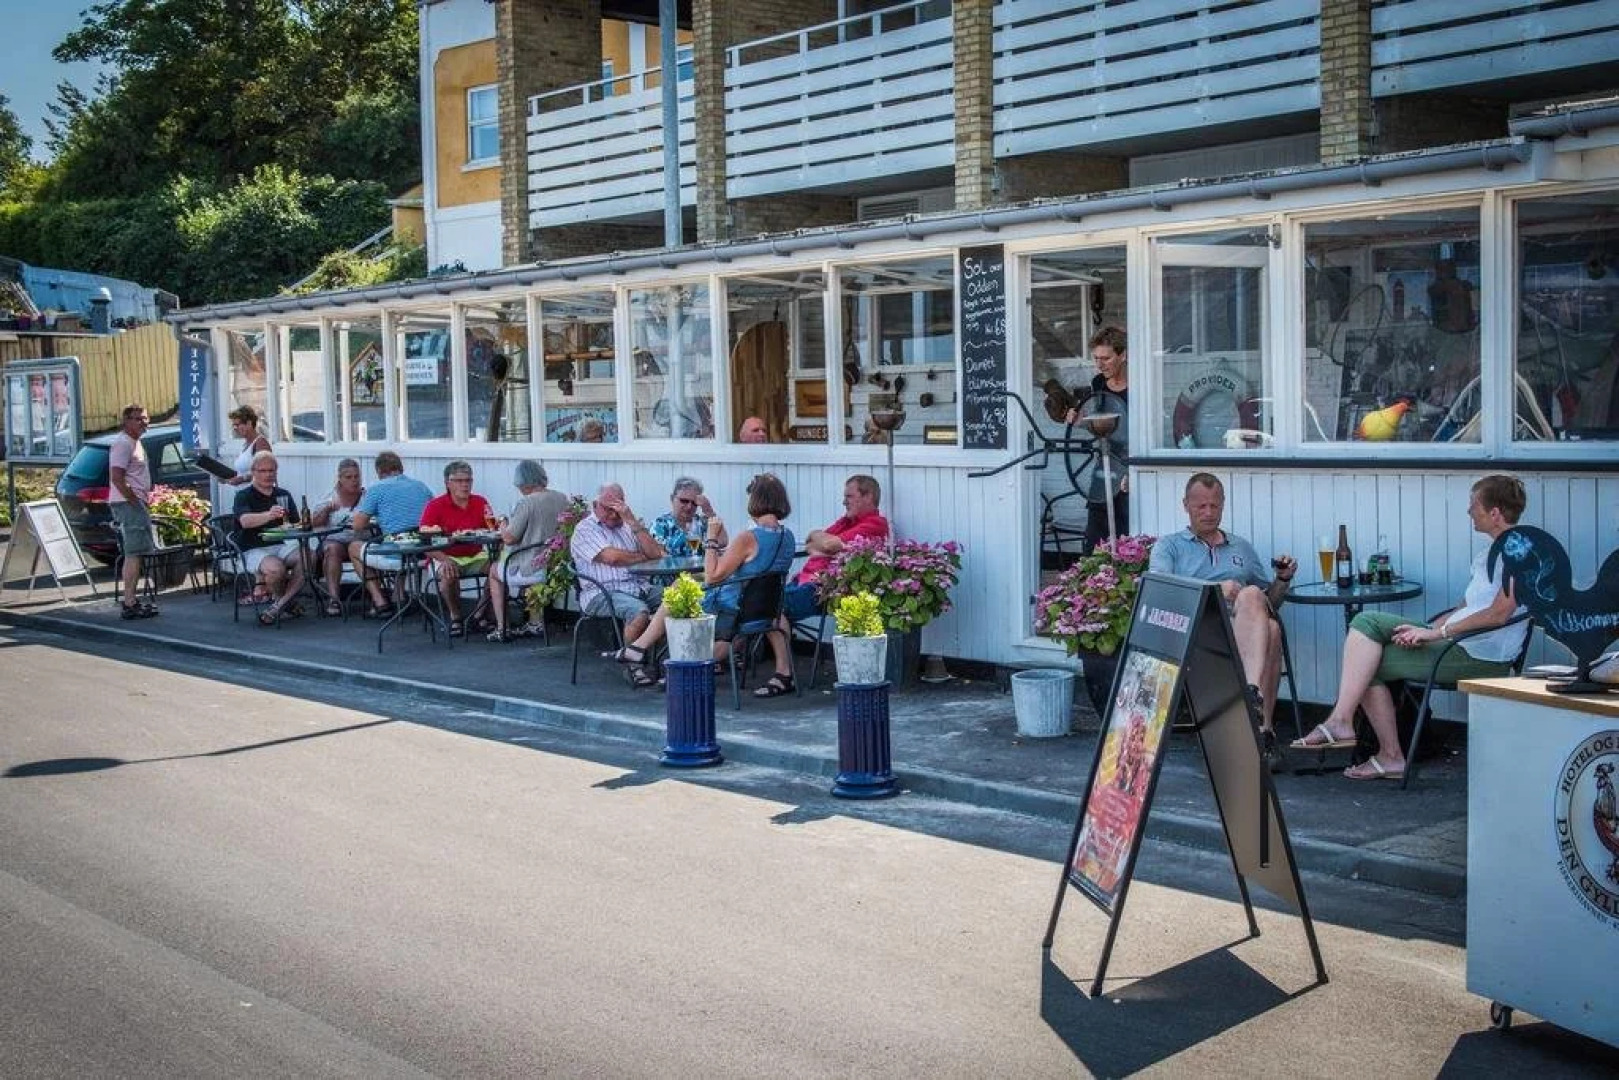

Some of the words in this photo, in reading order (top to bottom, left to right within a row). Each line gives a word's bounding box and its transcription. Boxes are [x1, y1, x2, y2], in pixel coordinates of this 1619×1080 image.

[1188, 375, 1236, 393] PROVIDER
[1562, 747, 1593, 795] HOTEL
[1593, 736, 1614, 752] OG
[1557, 818, 1579, 871] DEN
[1580, 875, 1619, 916] GYL
